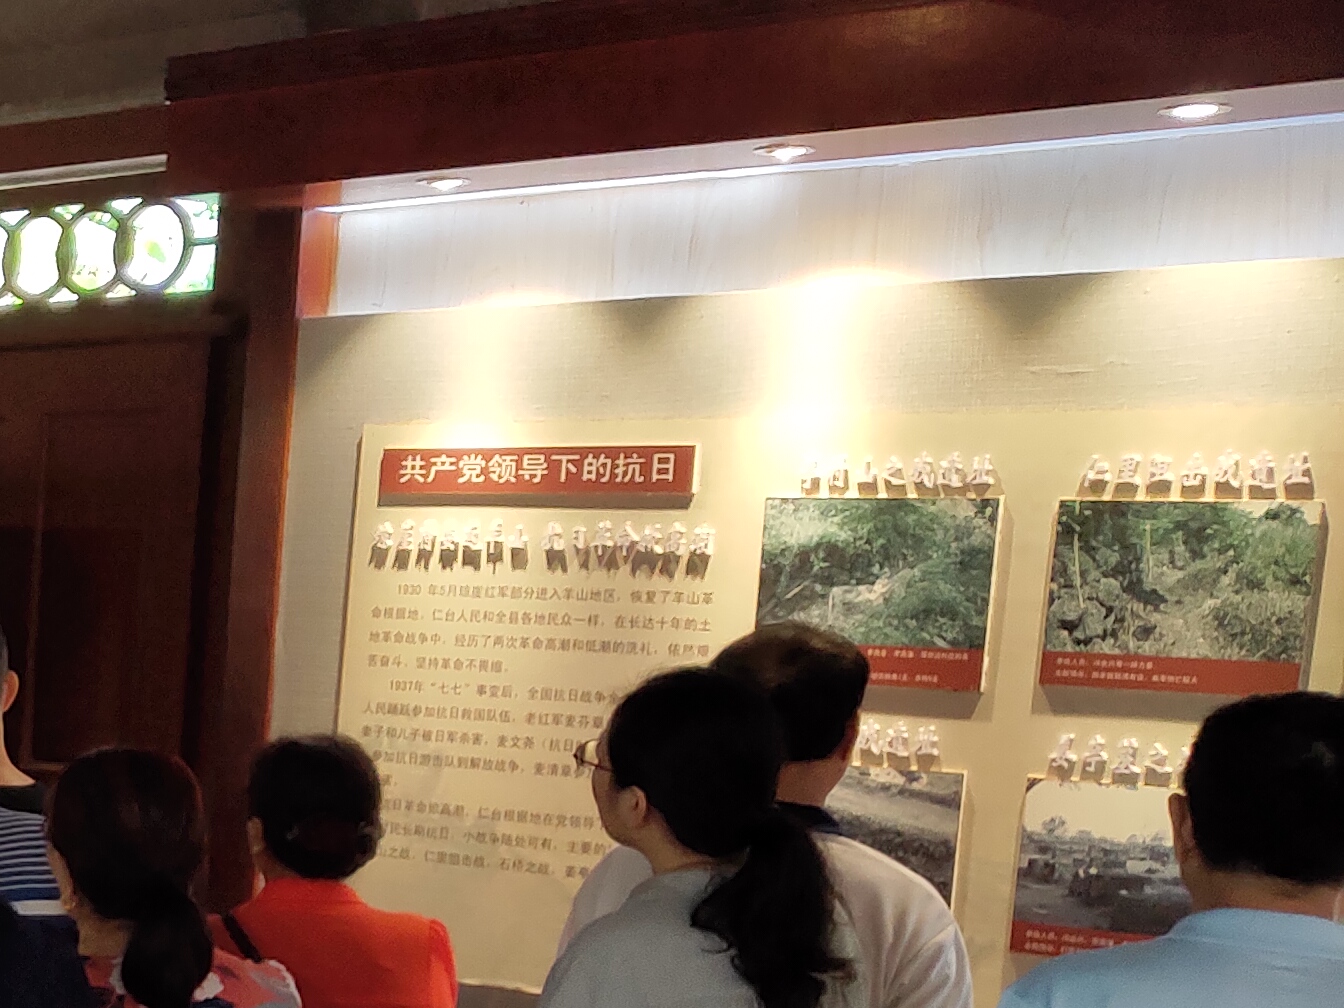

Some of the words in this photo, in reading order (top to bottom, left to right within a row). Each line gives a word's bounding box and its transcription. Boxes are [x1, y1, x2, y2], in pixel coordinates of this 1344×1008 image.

[399, 453, 676, 484] 共产党领导下的抗日
